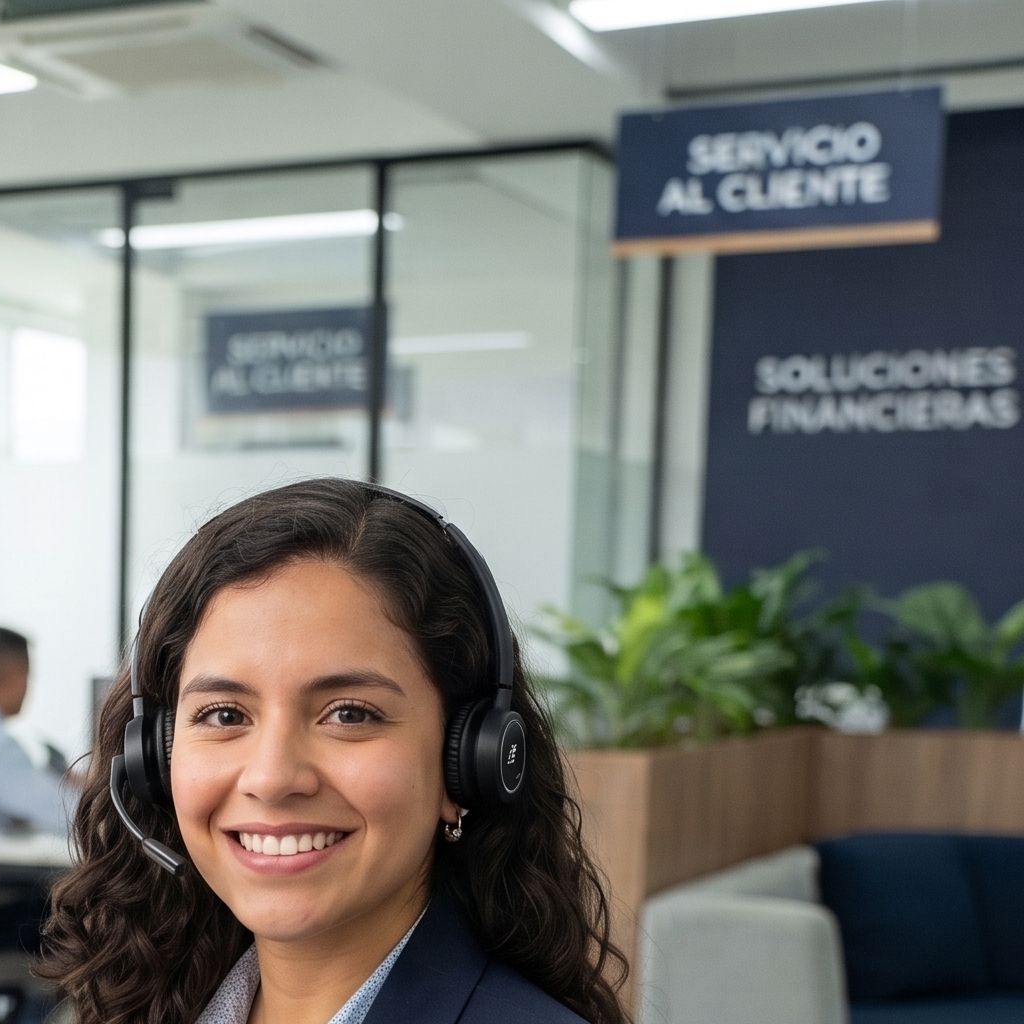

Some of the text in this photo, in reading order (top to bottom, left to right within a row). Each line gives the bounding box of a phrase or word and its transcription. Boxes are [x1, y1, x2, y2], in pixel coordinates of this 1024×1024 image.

[687, 121, 882, 176] SERVICIO
[657, 161, 891, 217] AL CLIENTE
[755, 346, 1016, 394] SOLUCIONES
[747, 388, 1020, 435] FINANCIERAS
